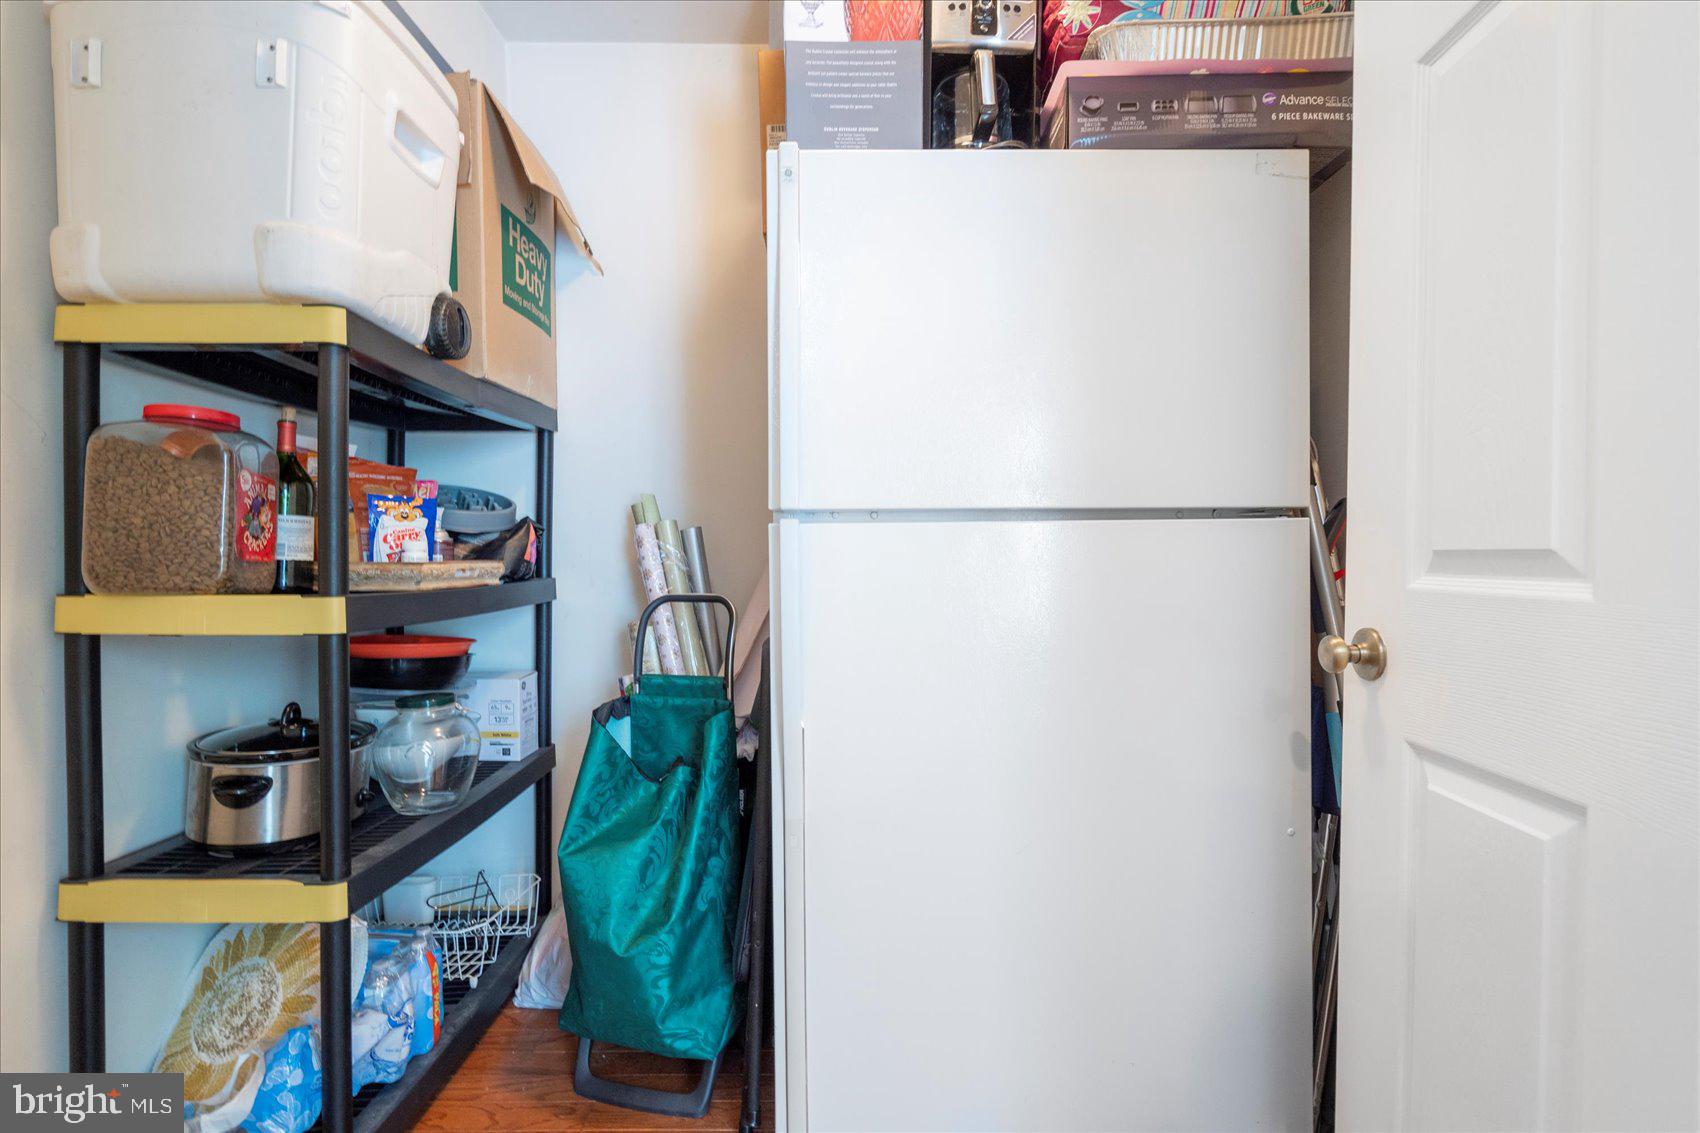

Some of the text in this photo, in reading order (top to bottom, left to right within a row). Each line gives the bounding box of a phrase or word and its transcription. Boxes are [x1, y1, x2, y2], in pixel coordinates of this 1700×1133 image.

[1280, 94, 1324, 105] Advance
[1302, 112, 1345, 120] BAKEWARE
[508, 216, 548, 281] Heavy
[515, 252, 545, 307] Duty
[504, 284, 523, 307] Moving
[523, 297, 532, 311] and
[244, 483, 271, 509] ANIMAL
[243, 521, 274, 552] CRACKERS
[383, 530, 421, 544] Carry
